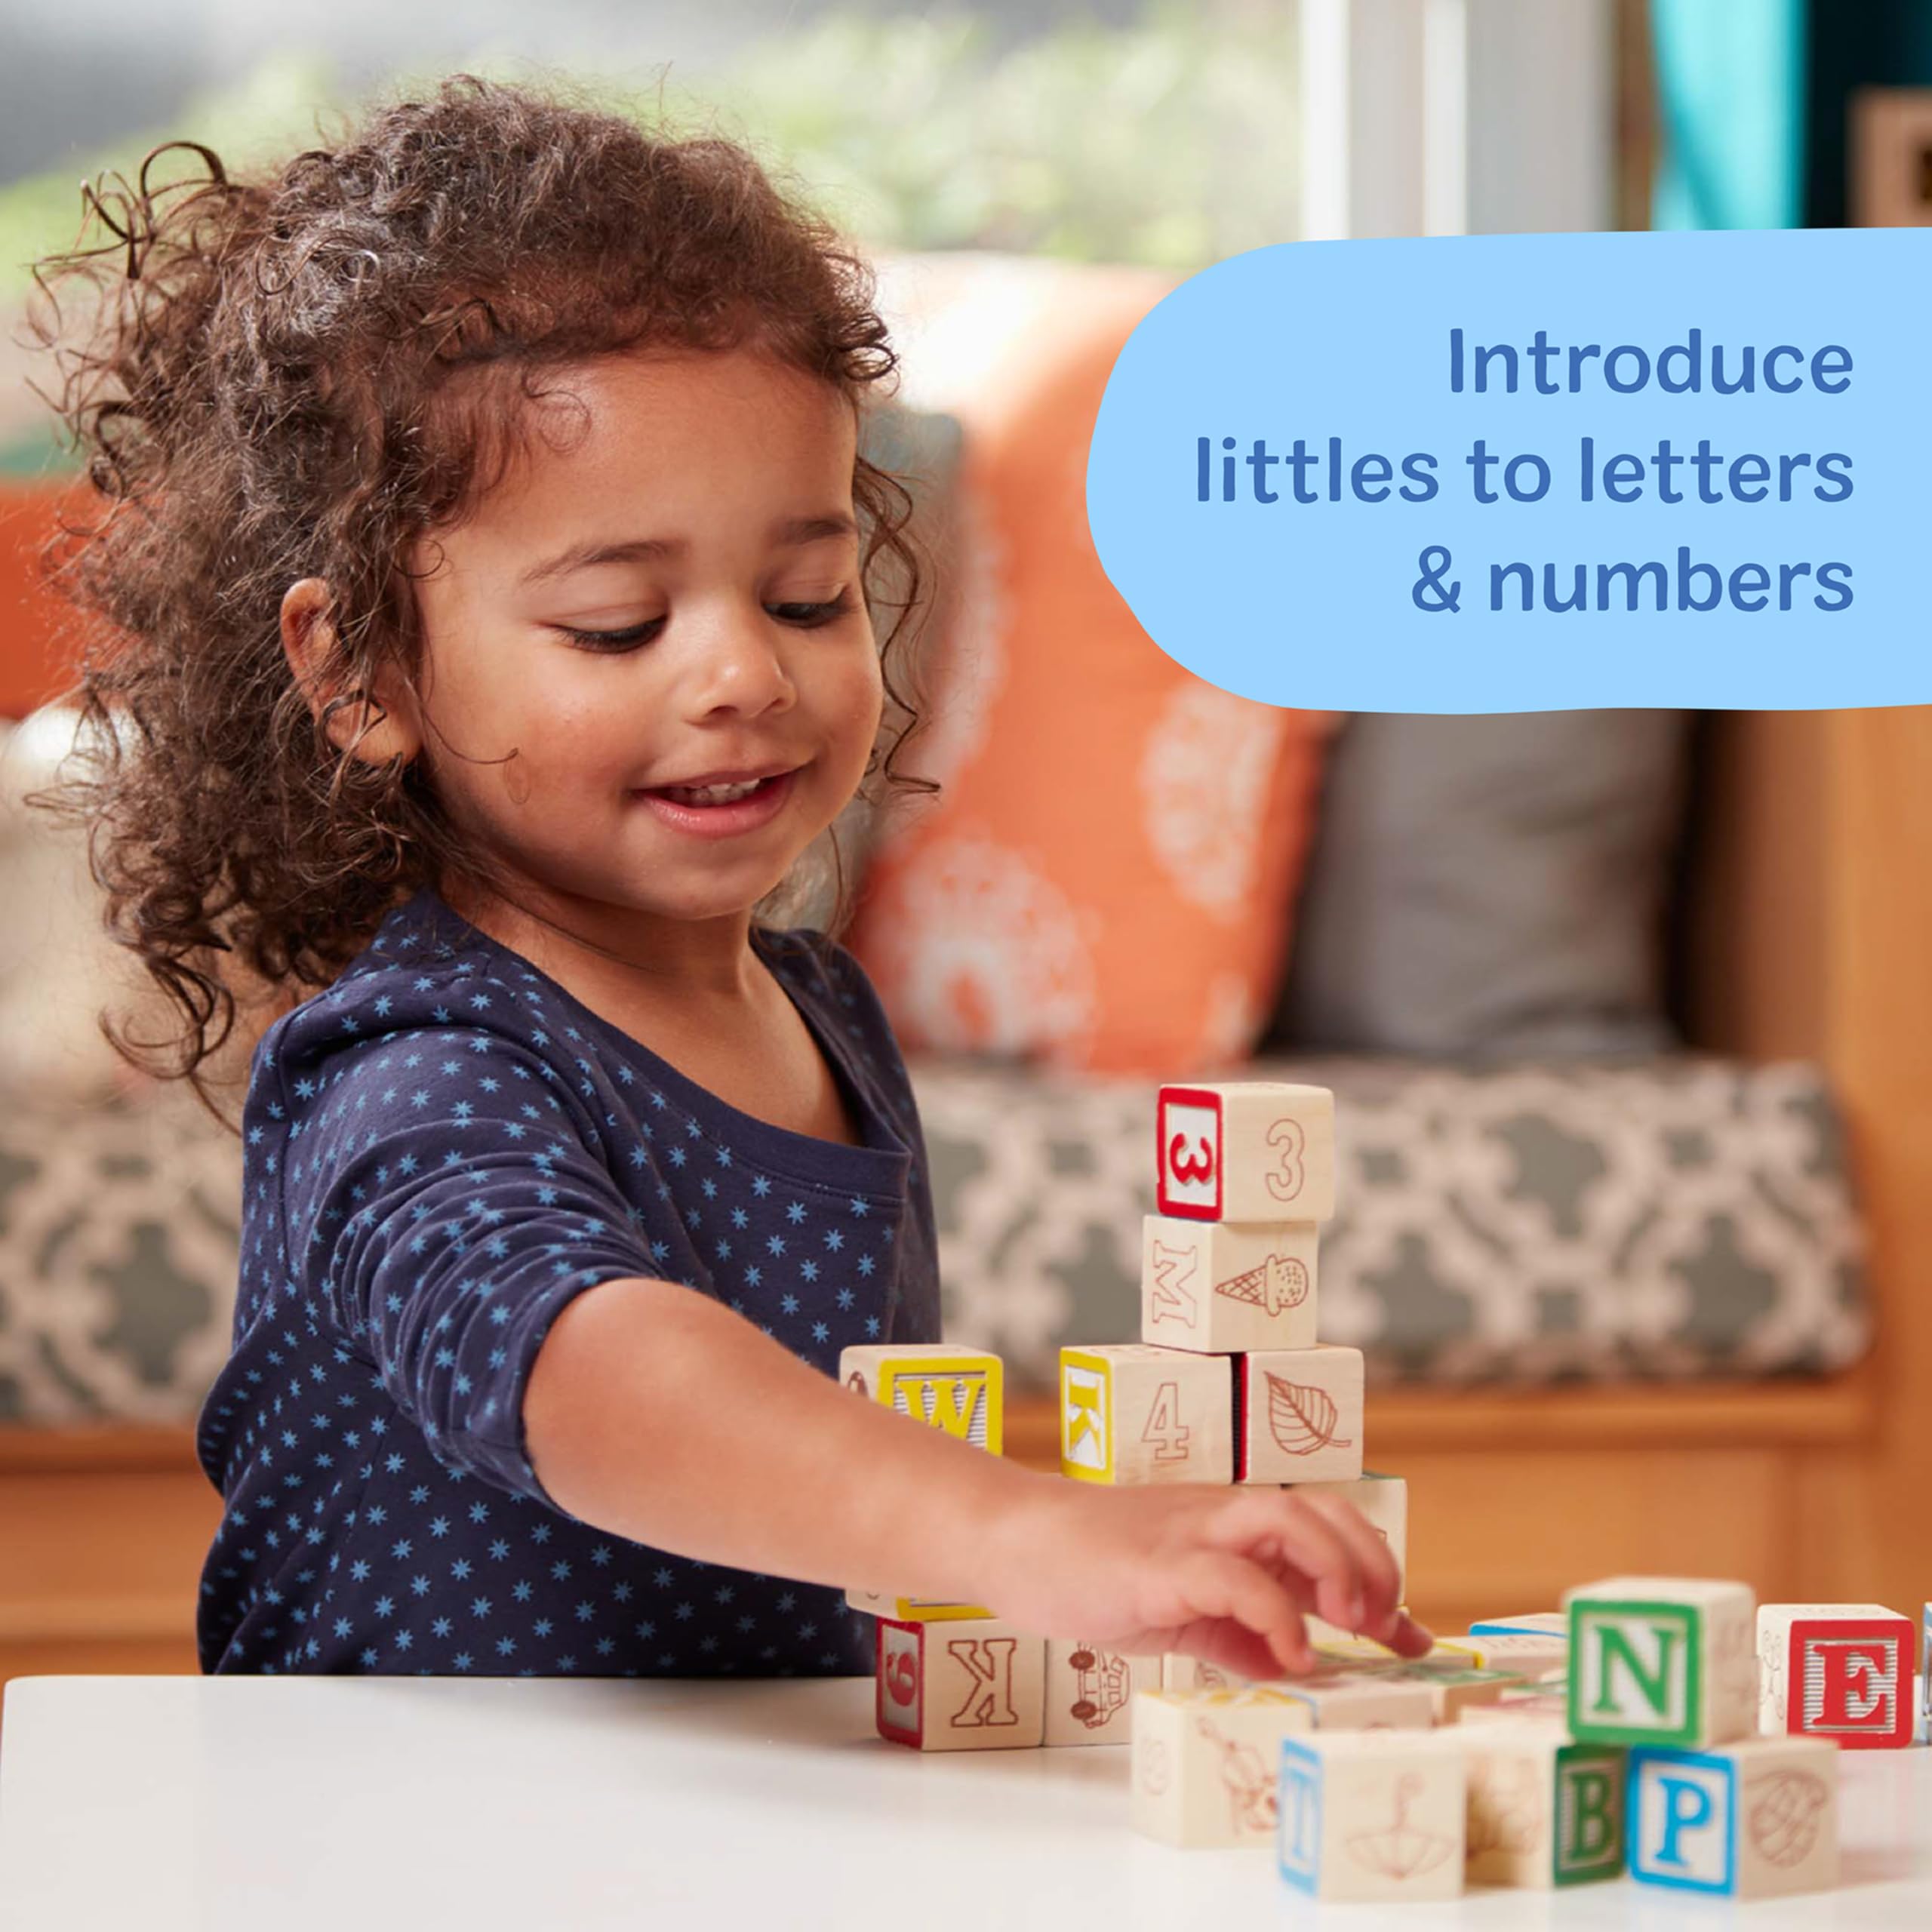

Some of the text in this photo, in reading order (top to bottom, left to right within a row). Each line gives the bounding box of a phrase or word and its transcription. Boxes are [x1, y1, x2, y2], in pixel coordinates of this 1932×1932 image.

[1171, 1133, 1213, 1185] 3
[1266, 1118, 1305, 1202] 3
[1152, 1239, 1198, 1329] M
[896, 1379, 986, 1440] W
[1141, 1382, 1189, 1460] 4
[948, 1638, 1019, 1727] K
[1592, 1626, 1678, 1715] N
[1812, 1644, 1887, 1726] E
[1568, 1773, 1612, 1861] B
[1654, 1777, 1712, 1867] P
